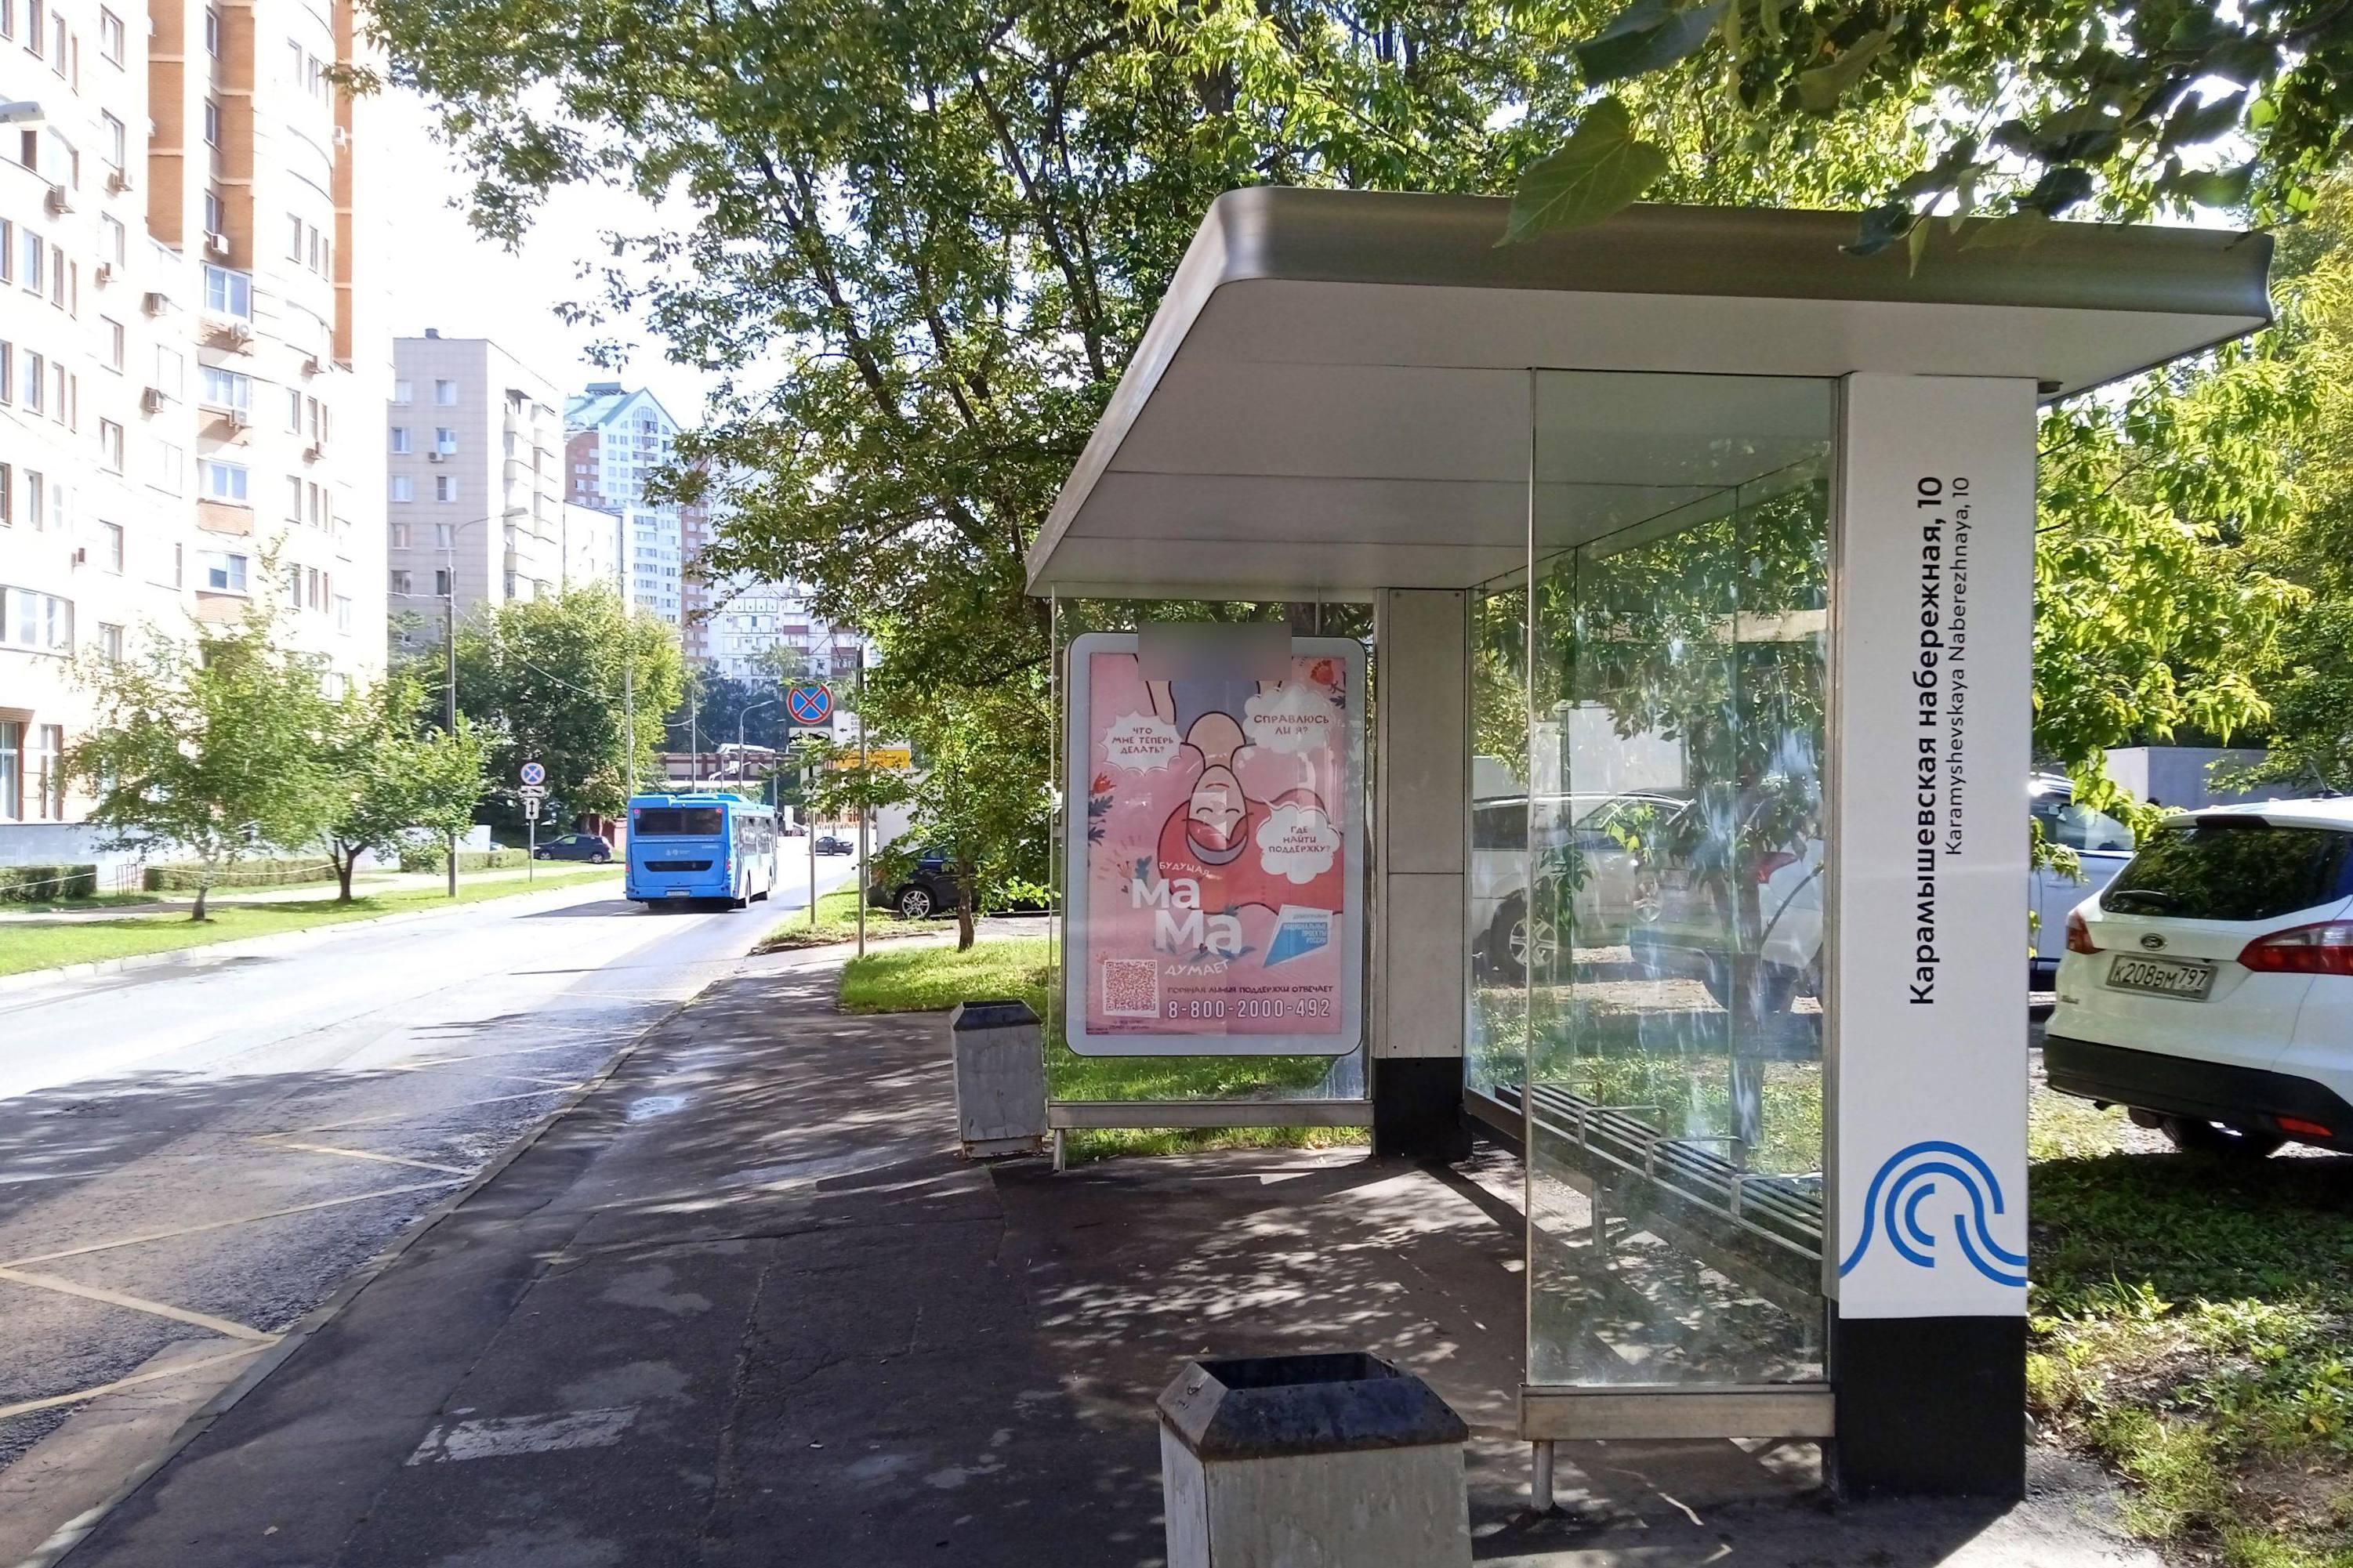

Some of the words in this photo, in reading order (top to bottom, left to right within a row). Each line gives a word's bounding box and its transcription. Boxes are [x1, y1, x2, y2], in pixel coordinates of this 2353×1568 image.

[1918, 476, 1942, 509] 10
[1952, 477, 1969, 498] 10
[1948, 504, 1971, 661] Naberezhnaya,
[1912, 518, 1946, 726] набережная,
[1254, 715, 1329, 723] СПРАВЛЮСЬ
[1945, 668, 1967, 854] Karamyshevskaya
[1283, 835, 1316, 843] НАЙТИ
[1159, 862, 1209, 876] БУДУЩАЯ
[1909, 738, 1940, 1004] Карамышевская
[1165, 960, 1229, 976] ДУМАЕТ
[1168, 998, 1331, 1019] 8-800-2000-492
